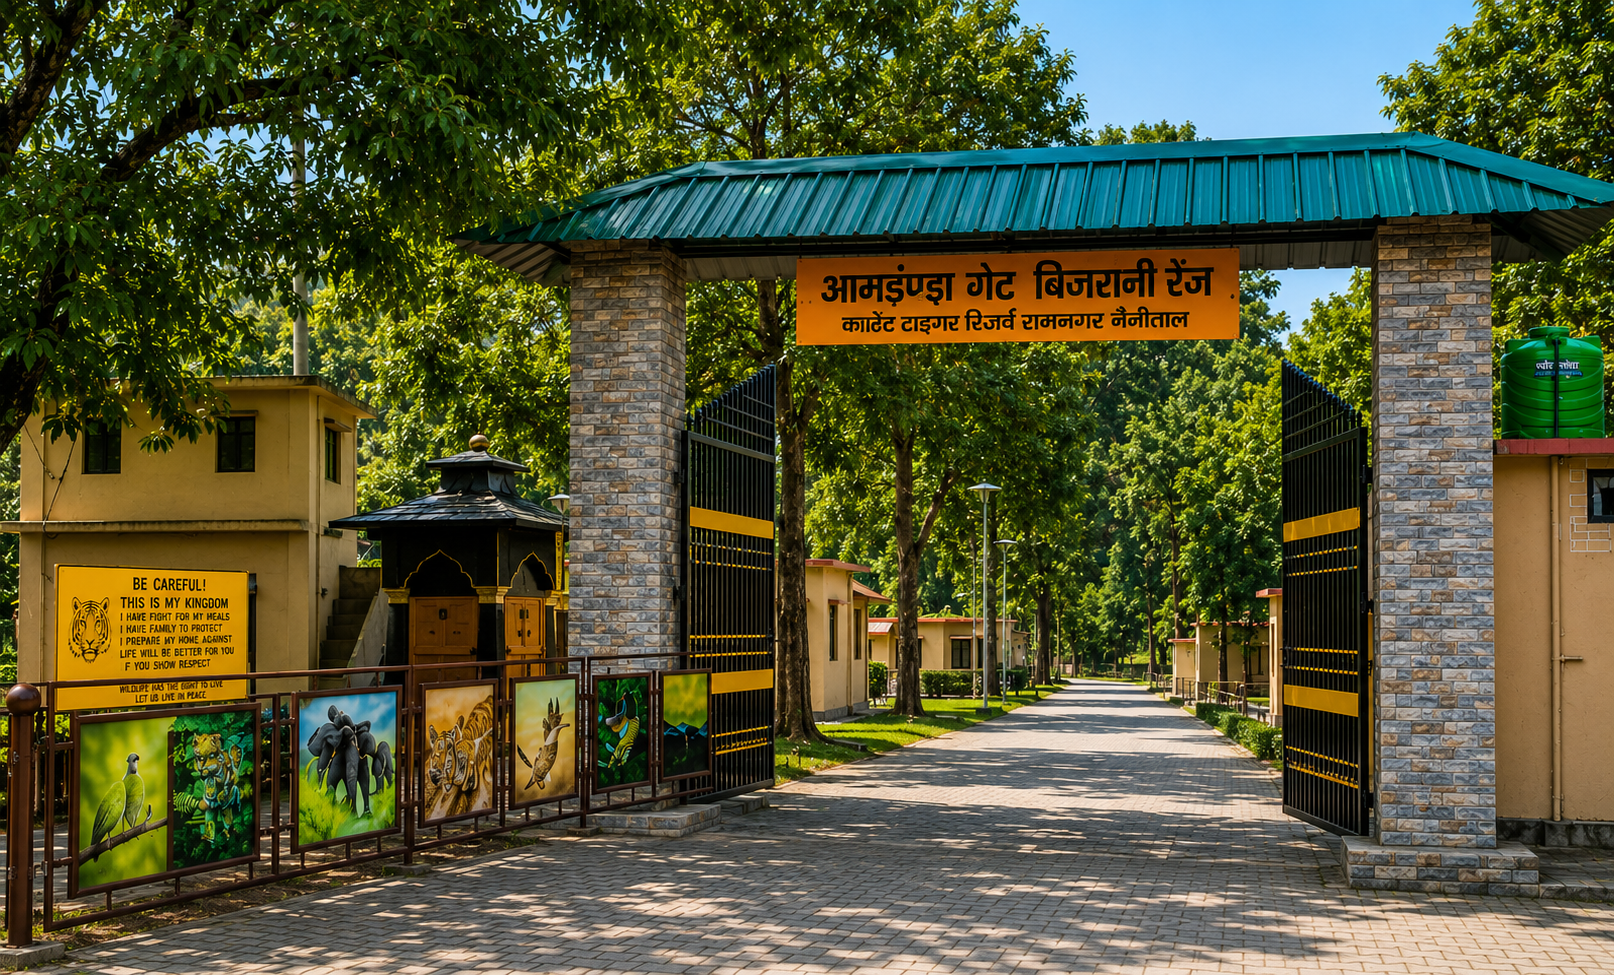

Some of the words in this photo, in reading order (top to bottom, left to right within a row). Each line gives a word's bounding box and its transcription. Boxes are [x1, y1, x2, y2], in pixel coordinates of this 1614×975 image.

[966, 262, 1017, 300] गेट
[1033, 258, 1158, 300] बिजरानी
[1165, 258, 1215, 297] रेंज
[901, 315, 960, 335] टाइगर
[965, 308, 1017, 332] रिजर्व
[1021, 312, 1105, 331] रामनगर
[1110, 305, 1190, 329] नैनीताल
[133, 577, 147, 590] BE
[153, 577, 206, 591] CAREFUL!
[120, 597, 145, 609] THIS
[150, 597, 160, 609] IS
[165, 597, 180, 609] MY
[185, 598, 229, 609] KINGDOM
[149, 613, 172, 622] FIGHT
[175, 613, 190, 622] FOR
[179, 624, 189, 633] TO
[191, 624, 223, 633] PROTECT
[120, 649, 137, 659] LIFE
[140, 648, 159, 658] WILL
[174, 647, 203, 657] BETTER
[205, 647, 219, 656] FOR
[134, 661, 150, 671] YOU
[153, 660, 176, 670] SHOW
[179, 658, 211, 669] RESPECT
